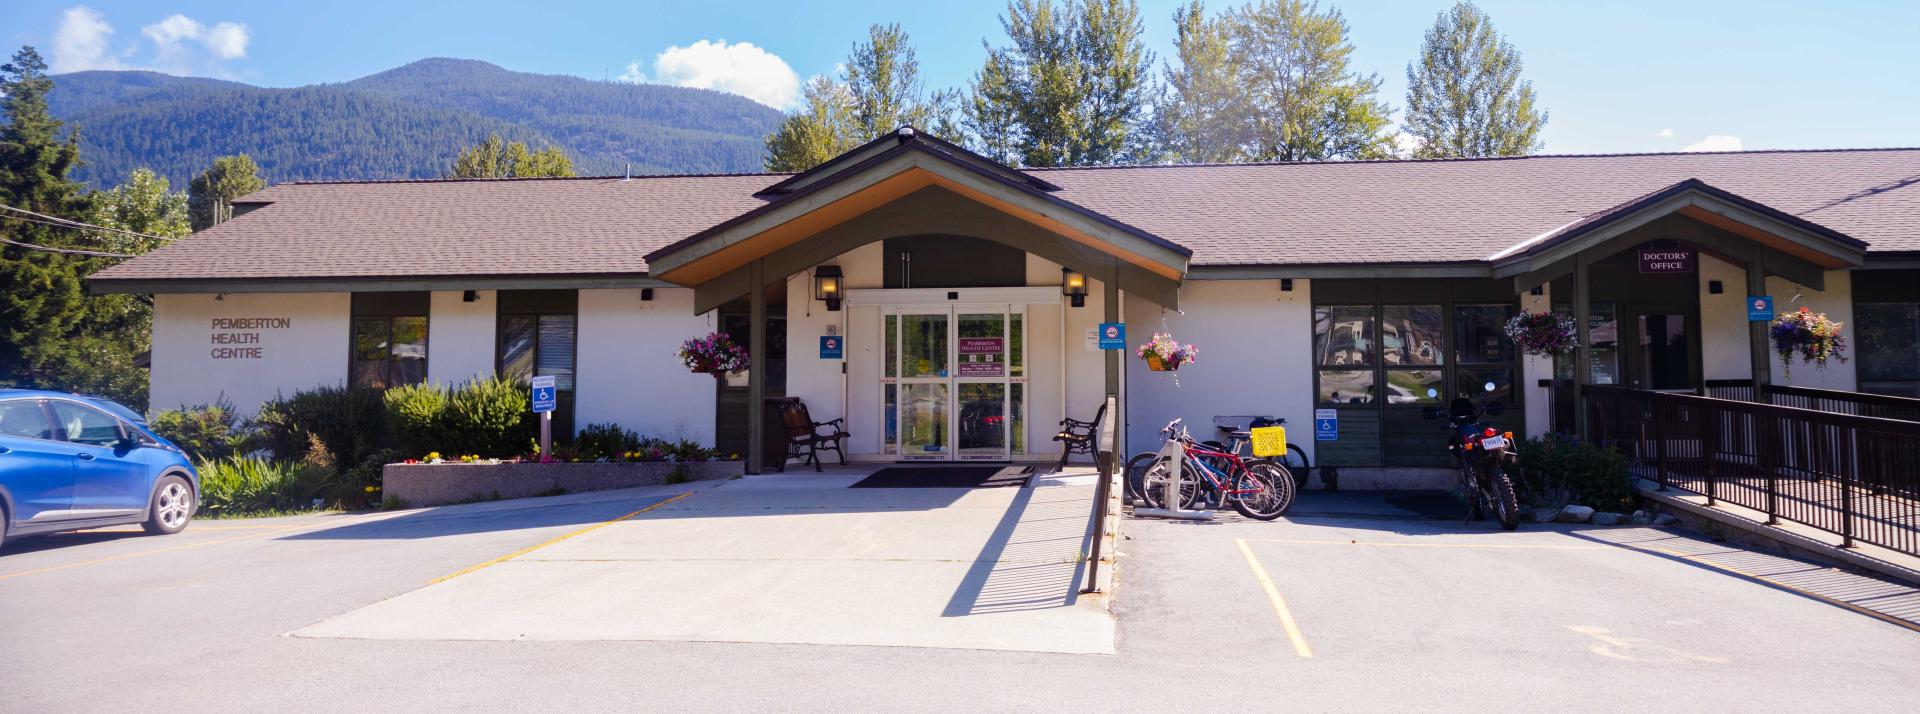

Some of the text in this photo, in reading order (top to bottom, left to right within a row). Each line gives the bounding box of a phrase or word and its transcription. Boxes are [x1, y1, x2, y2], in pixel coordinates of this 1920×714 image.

[1643, 252, 1689, 260] DOCTORS'
[211, 317, 290, 329] PEMBERTON
[211, 332, 259, 344] HEALTH
[210, 347, 263, 359] CENTRE
